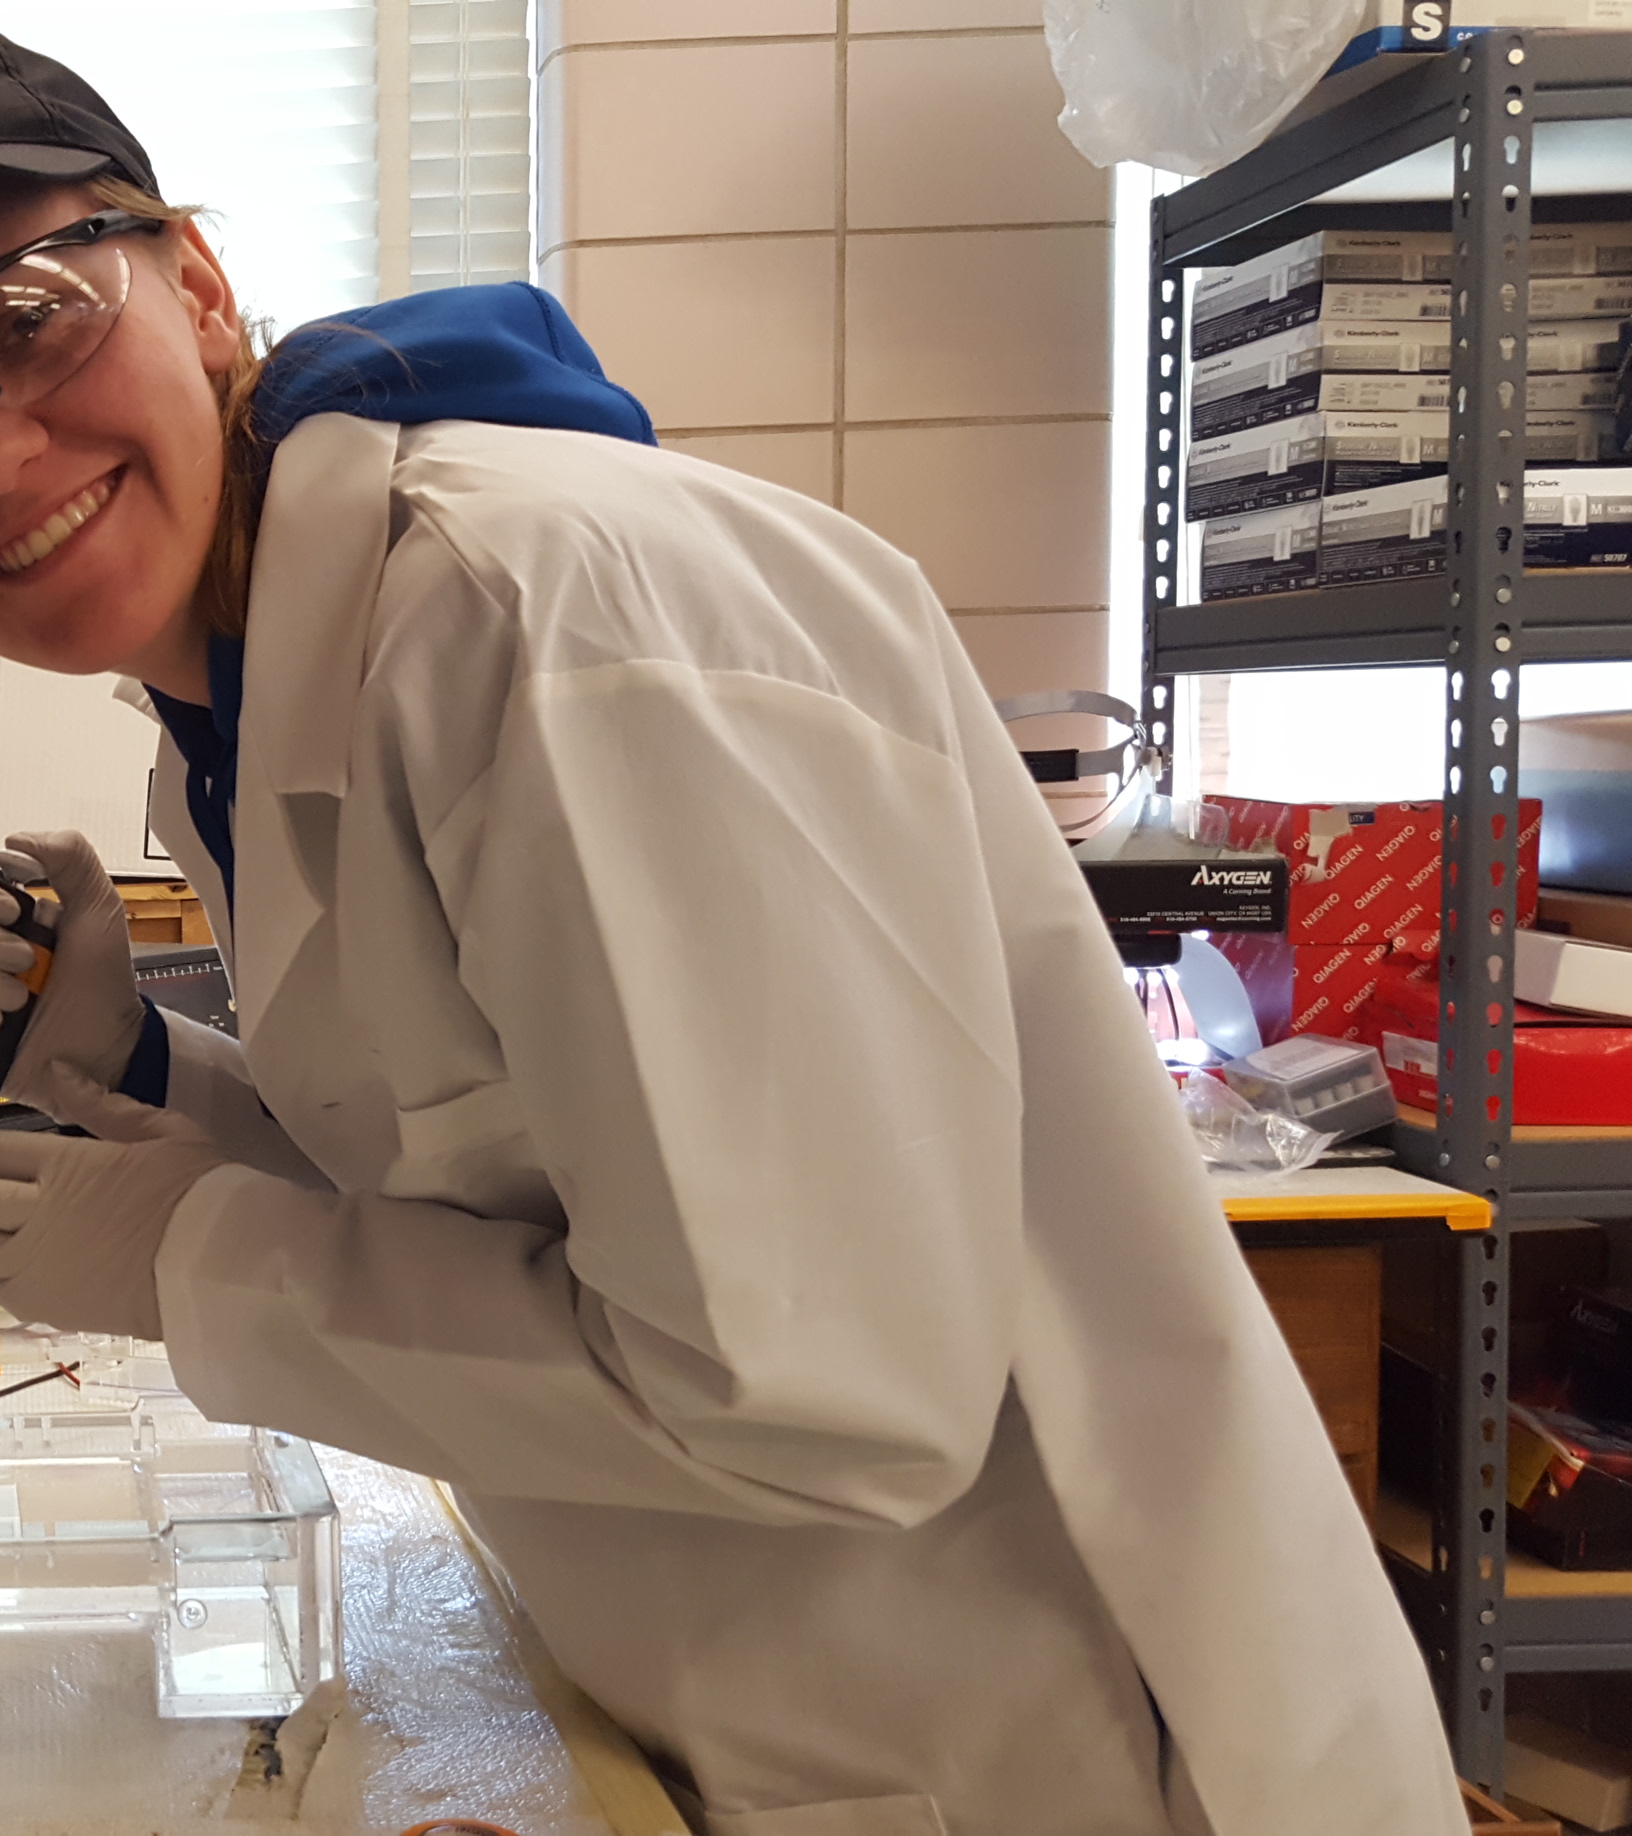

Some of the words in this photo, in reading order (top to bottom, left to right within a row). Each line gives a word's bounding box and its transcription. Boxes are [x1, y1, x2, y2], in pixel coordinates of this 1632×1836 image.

[1411, 2, 1434, 41] S
[1590, 503, 1603, 515] M
[1376, 825, 1416, 861] QIAGEN
[1191, 865, 1272, 885] AXYGEN
[1325, 844, 1364, 880] QIAGEN
[1354, 874, 1394, 910] QIAGEN
[1301, 893, 1340, 929] QIAGEN
[1383, 903, 1424, 939] QIAGEN
[1313, 948, 1353, 984] QIAGEN
[1291, 996, 1330, 1032] QIAGEN
